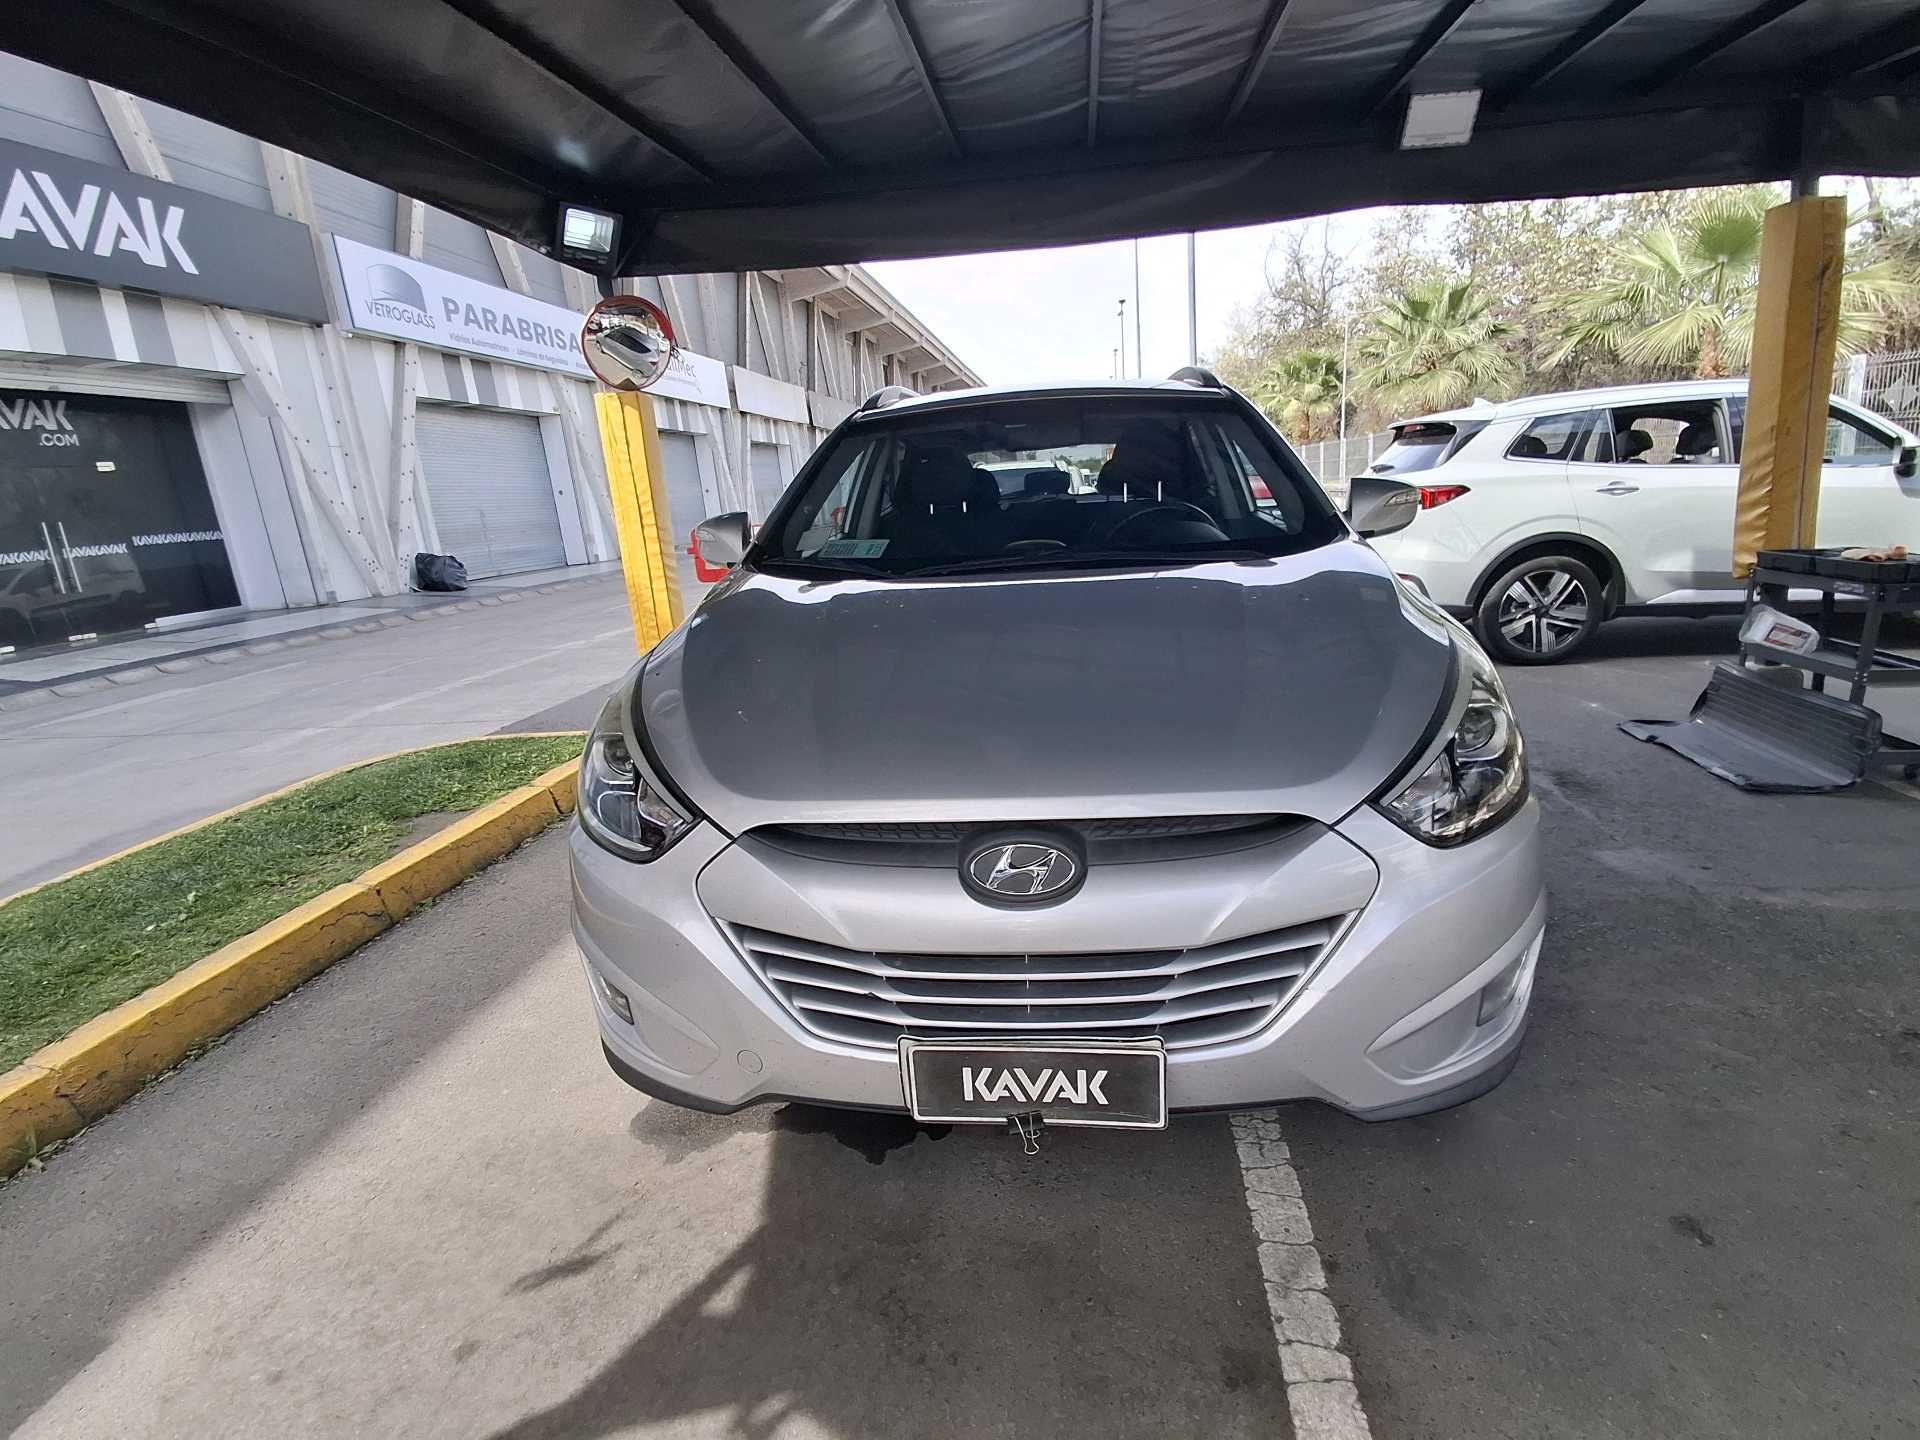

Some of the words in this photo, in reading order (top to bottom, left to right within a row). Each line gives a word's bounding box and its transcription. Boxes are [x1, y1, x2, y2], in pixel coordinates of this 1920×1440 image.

[365, 299, 436, 329] VETROGLASS
[39, 432, 81, 447] .COM
[962, 1066, 1110, 1105] KAVAK
